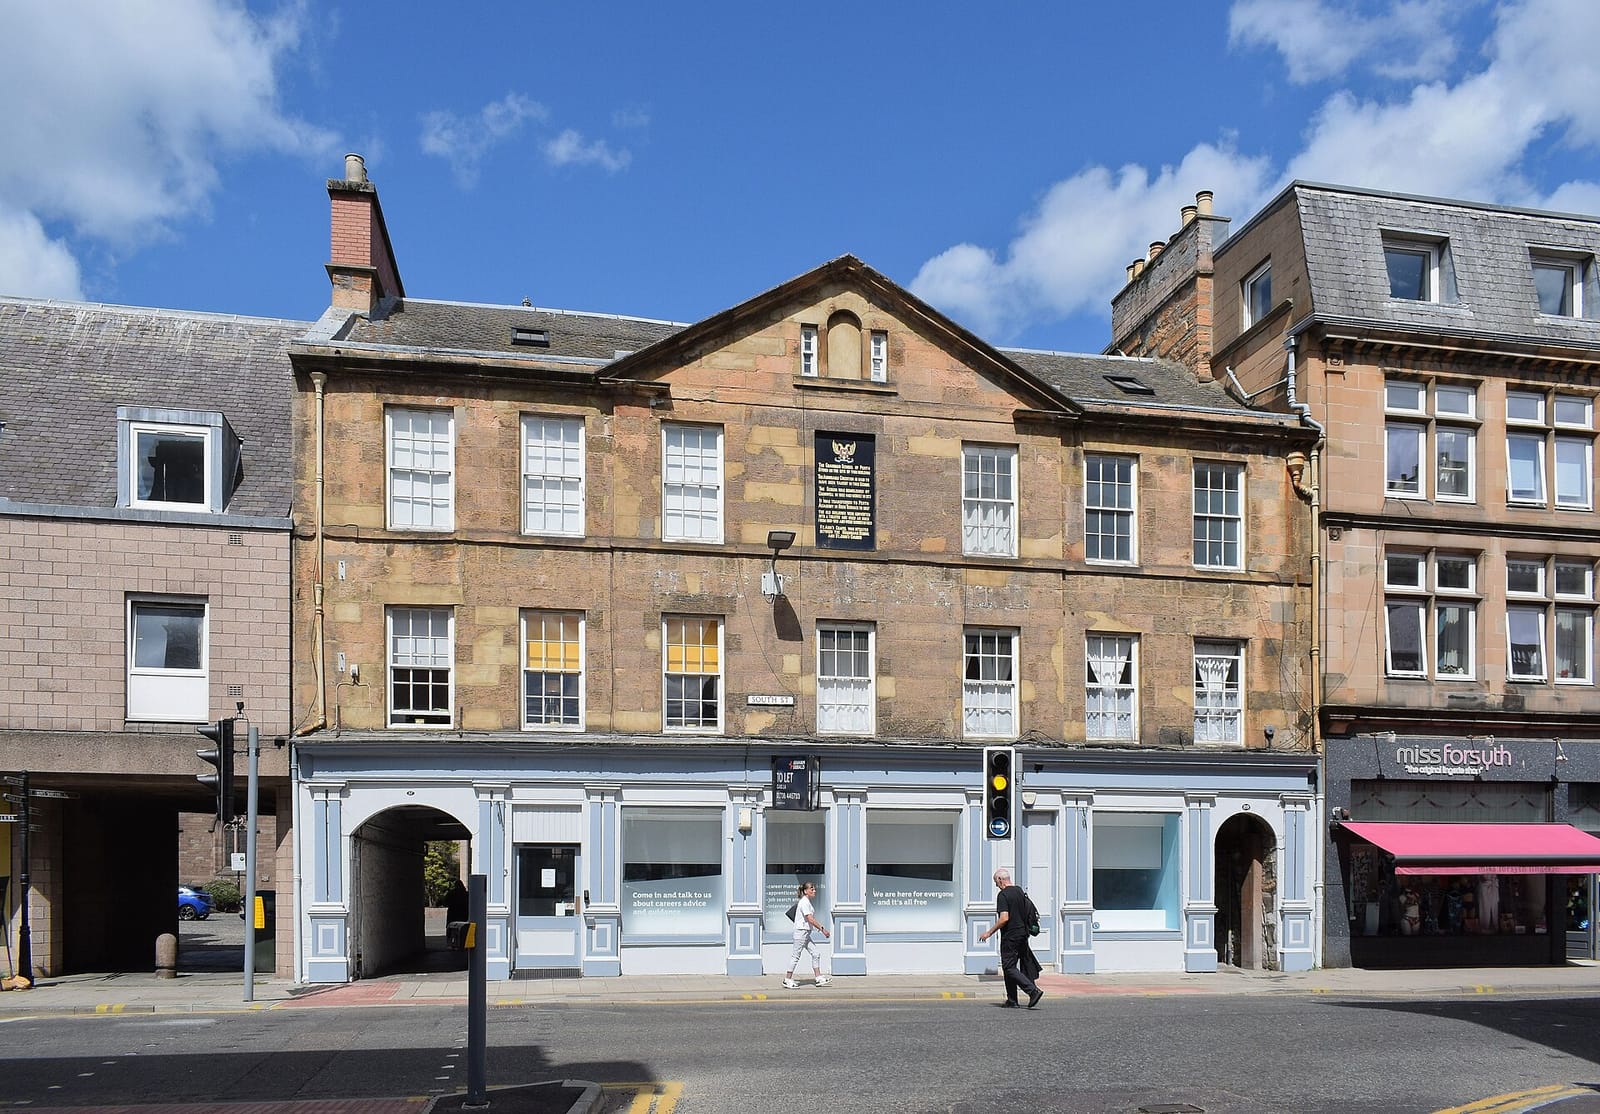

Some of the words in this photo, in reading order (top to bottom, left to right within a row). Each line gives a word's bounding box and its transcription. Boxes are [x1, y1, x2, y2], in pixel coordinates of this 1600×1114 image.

[1396, 744, 1442, 764] miss
[1443, 744, 1512, 770] forsyth
[776, 772, 783, 782] TO
[784, 772, 794, 783] LET
